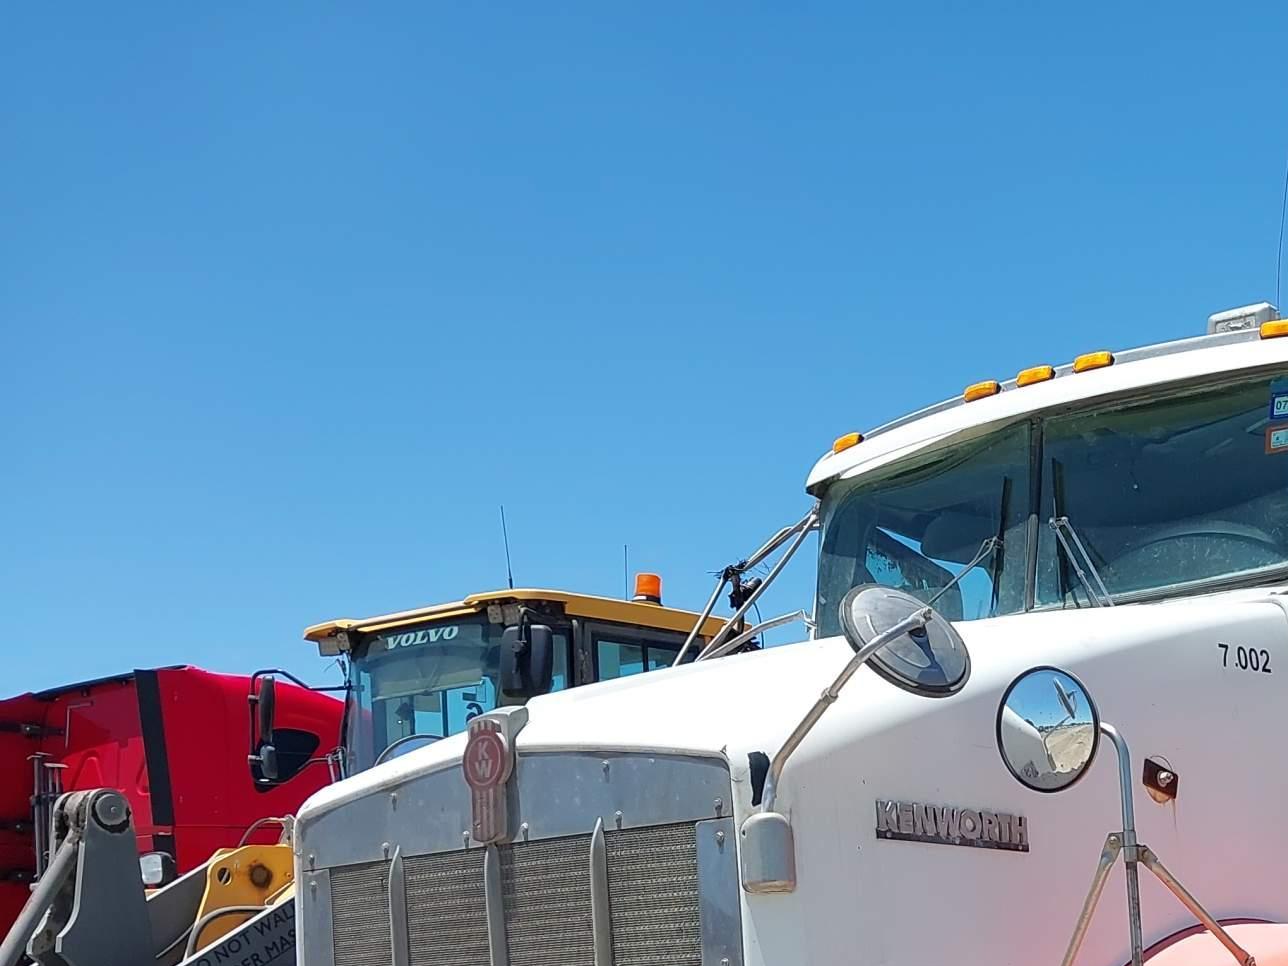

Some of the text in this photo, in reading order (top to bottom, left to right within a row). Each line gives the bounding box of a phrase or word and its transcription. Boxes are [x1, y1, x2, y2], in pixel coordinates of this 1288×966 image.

[1276, 400, 1288, 410] 07
[386, 626, 458, 650] VOLVO
[875, 800, 1028, 846] KENWORTH
[214, 930, 251, 962] NOT
[254, 902, 296, 937] WAL
[264, 928, 296, 959] MAS
